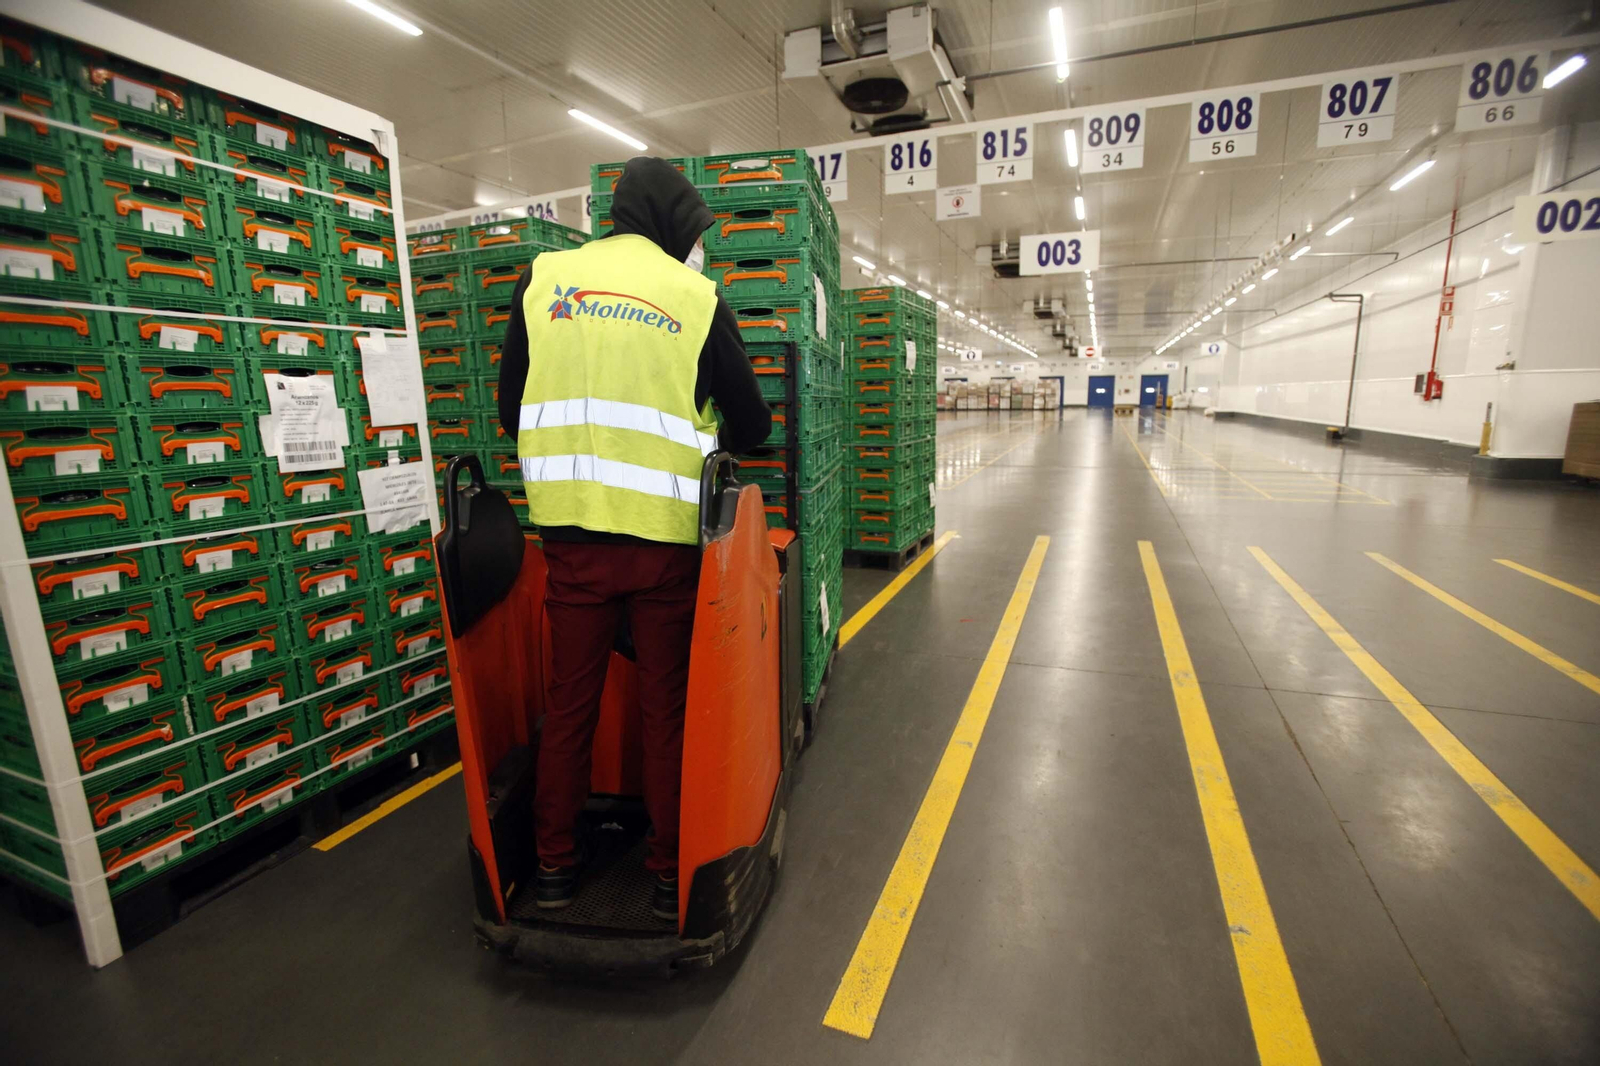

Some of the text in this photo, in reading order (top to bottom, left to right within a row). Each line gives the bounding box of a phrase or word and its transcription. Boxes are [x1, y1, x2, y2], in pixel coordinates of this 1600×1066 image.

[1468, 54, 1540, 100] 806
[1327, 76, 1393, 119] 807
[1197, 96, 1253, 135] 808
[1485, 105, 1515, 123] 66
[982, 127, 1028, 161] 815
[1088, 112, 1141, 147] 809
[1344, 122, 1369, 139] 79
[890, 139, 932, 171] 816
[1102, 152, 1123, 168] 34
[1211, 139, 1235, 155] 56
[808, 152, 842, 181] 17
[907, 175, 915, 186] 4
[996, 164, 1016, 178] 74
[1536, 196, 1600, 234] 002
[1037, 239, 1081, 267] 003
[575, 299, 683, 334] Molinero
